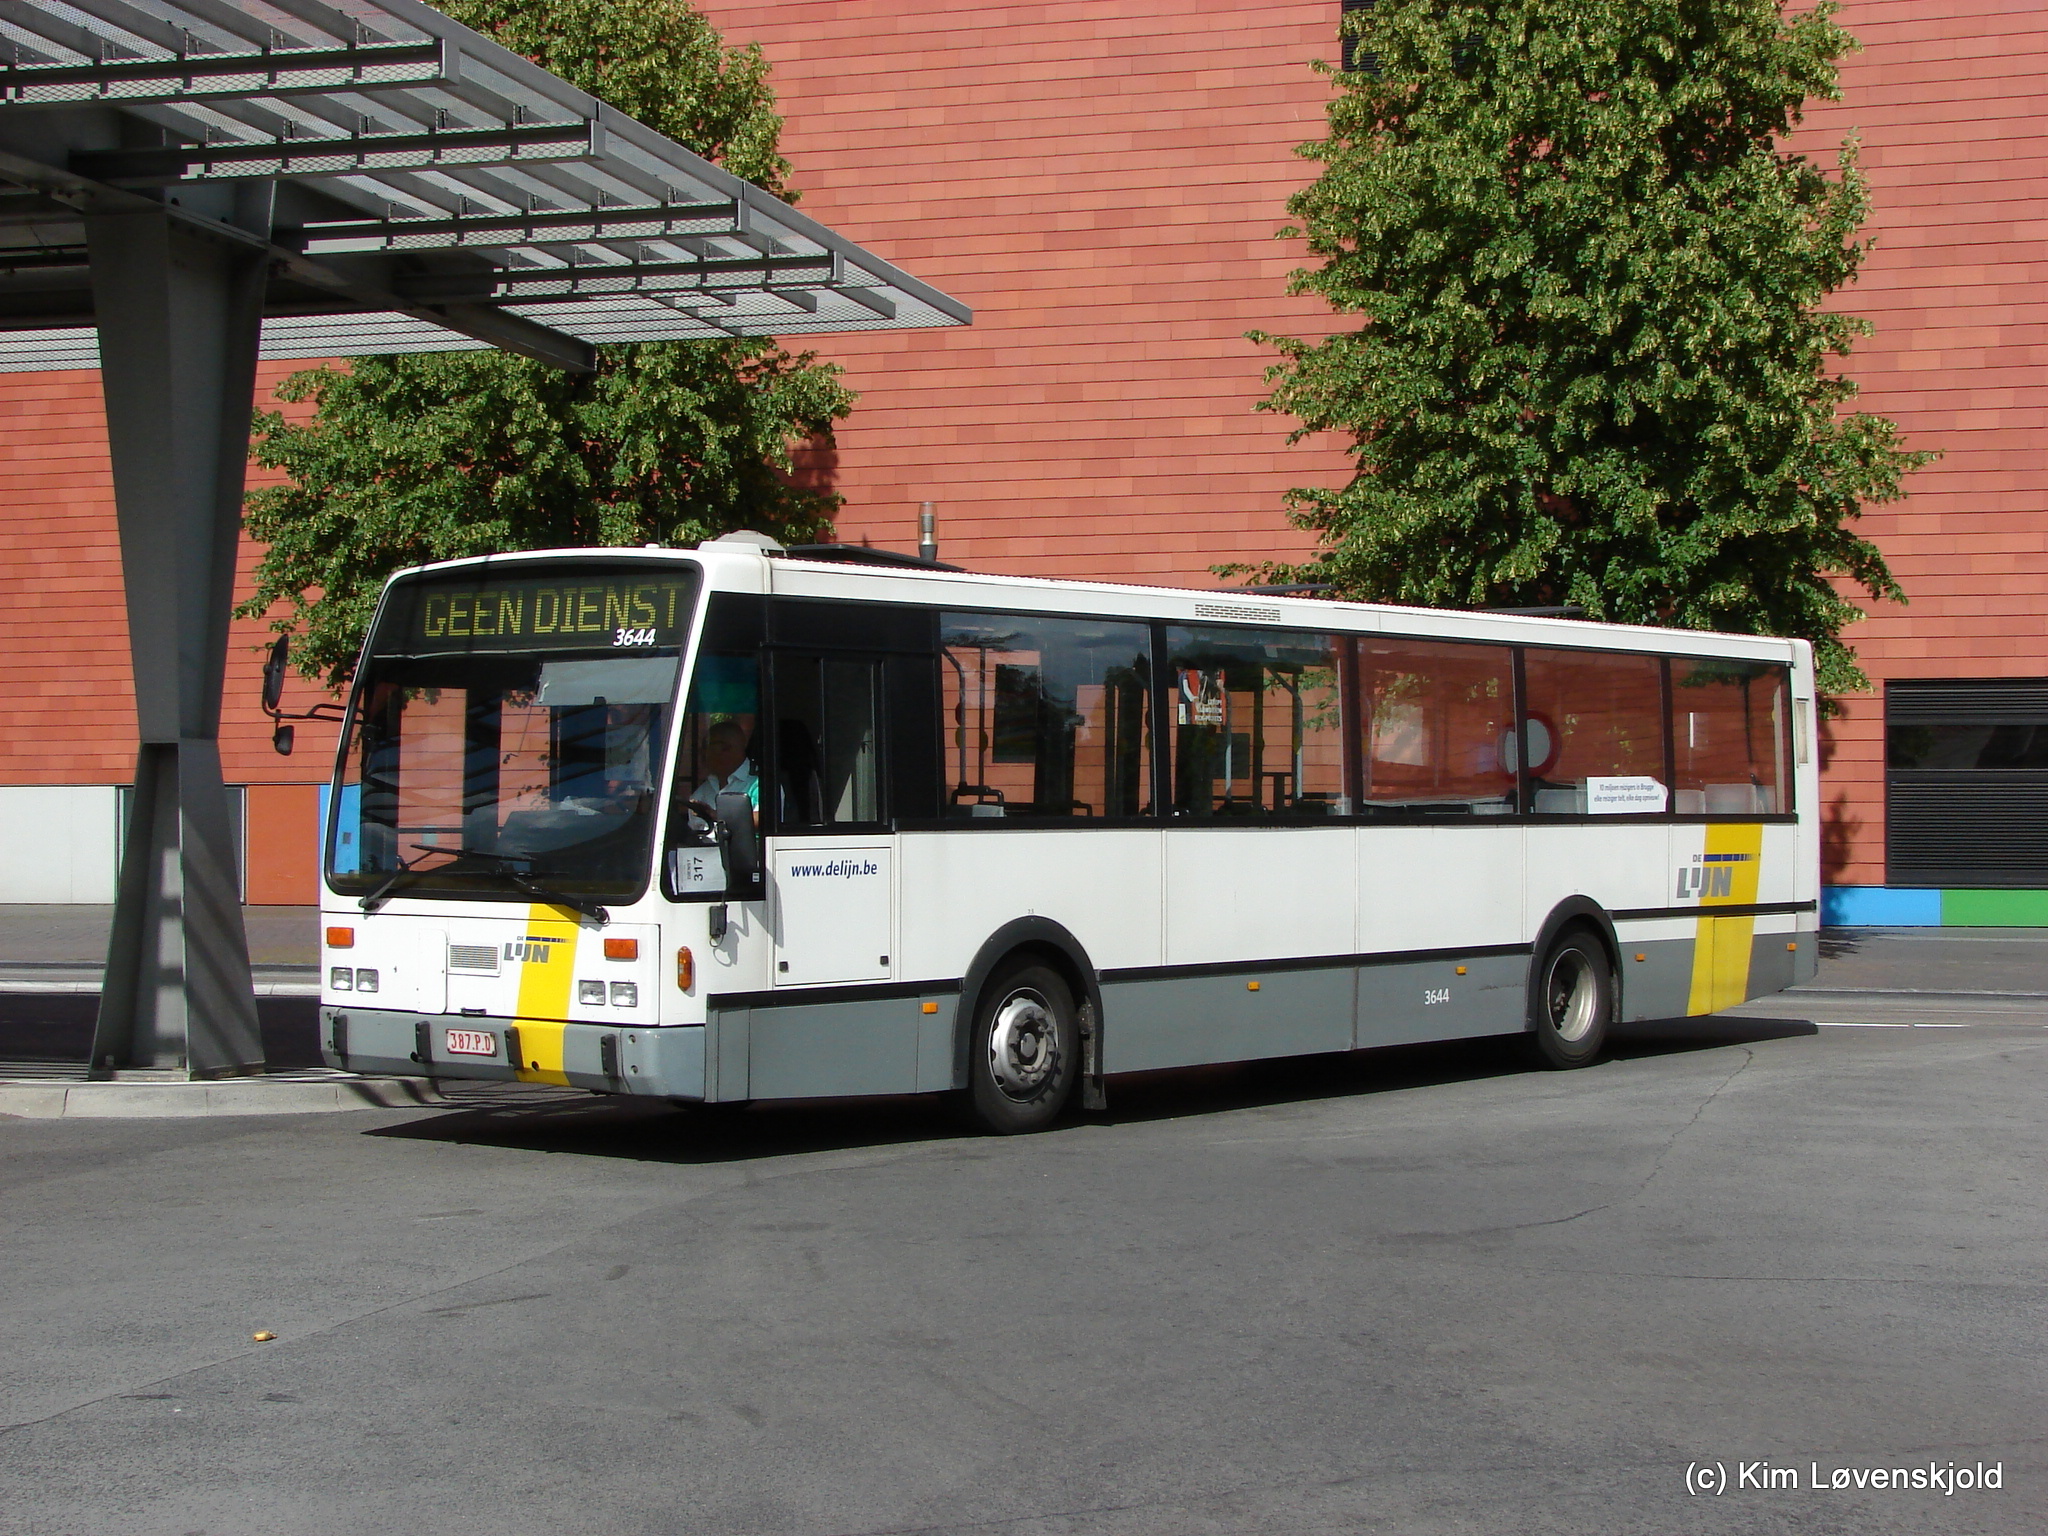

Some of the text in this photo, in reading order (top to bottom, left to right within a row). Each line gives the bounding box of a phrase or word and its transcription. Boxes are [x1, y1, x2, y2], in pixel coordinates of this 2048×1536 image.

[423, 582, 686, 637] GEEN DIENST
[613, 628, 656, 647] 3644
[1692, 854, 1702, 862] DE
[694, 857, 703, 881] 317
[791, 860, 878, 879] www.delijn.be
[1676, 867, 1733, 898] LIJN
[504, 943, 550, 963] LIJN
[1424, 988, 1450, 1005] 3644
